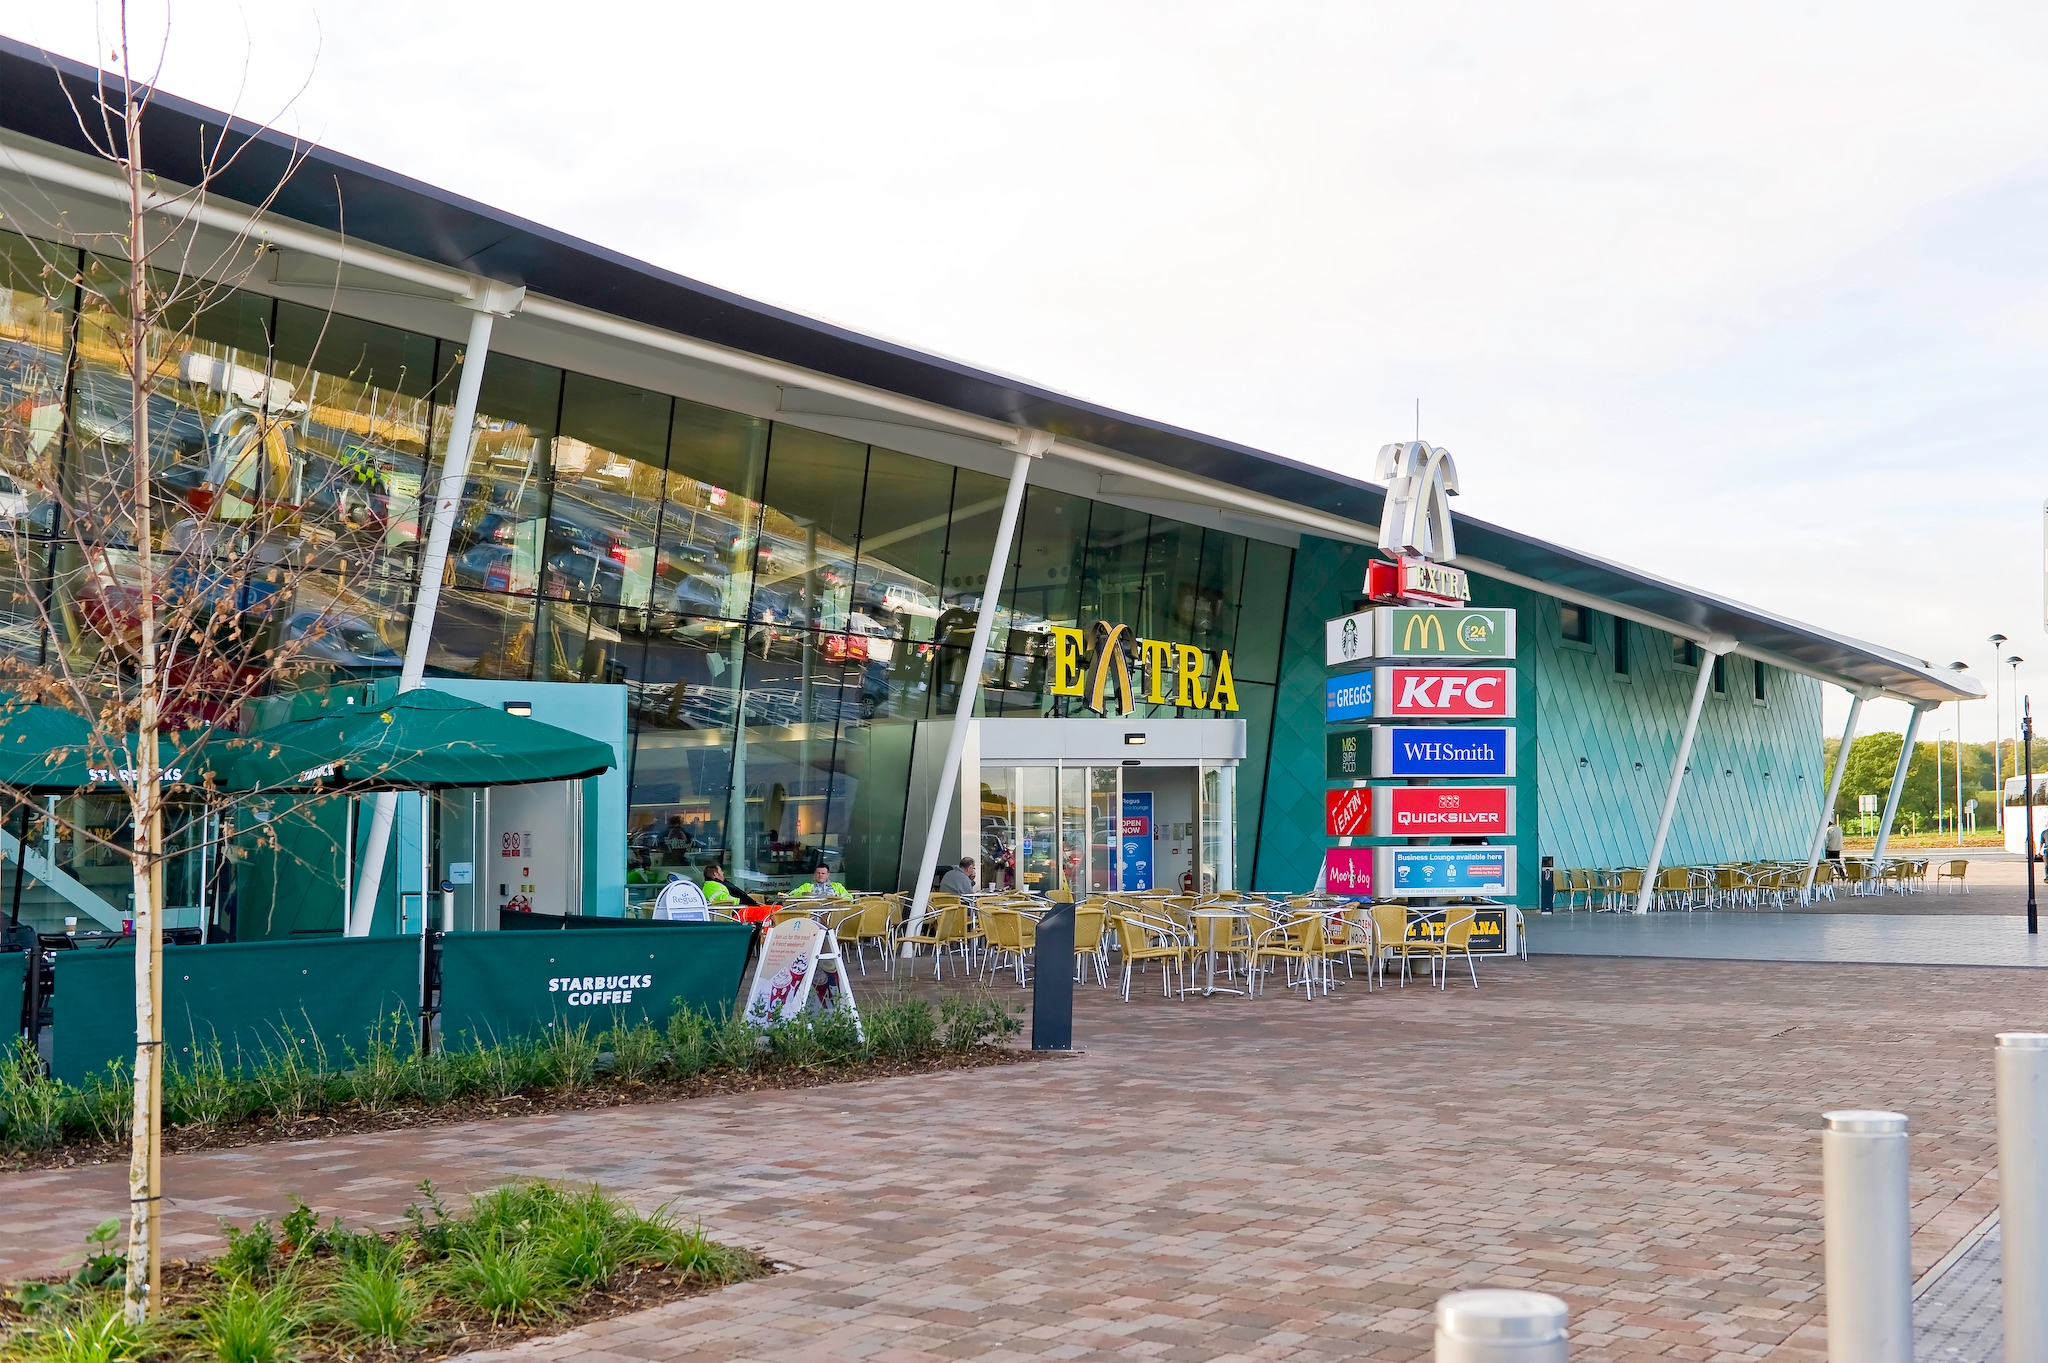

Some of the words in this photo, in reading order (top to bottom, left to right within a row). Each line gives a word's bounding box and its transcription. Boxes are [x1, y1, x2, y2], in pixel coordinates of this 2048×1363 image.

[1416, 564, 1471, 601] EXTRA
[1470, 625, 1486, 638] 24
[1336, 684, 1372, 708] GREGGS
[1397, 676, 1498, 709] KFC
[1342, 737, 1356, 752] M&S
[1404, 743, 1495, 761] WHSmith
[1342, 762, 1356, 773] FOOD
[1398, 811, 1499, 825] QUICKSILVER
[1429, 854, 1455, 862] Lounge
[1357, 869, 1370, 888] dog
[672, 895, 698, 905] Regus
[1421, 921, 1500, 936] MEANA
[1351, 934, 1371, 944] NOODE
[548, 974, 652, 992] STARBUCKS
[567, 990, 633, 1006] COFFEE
